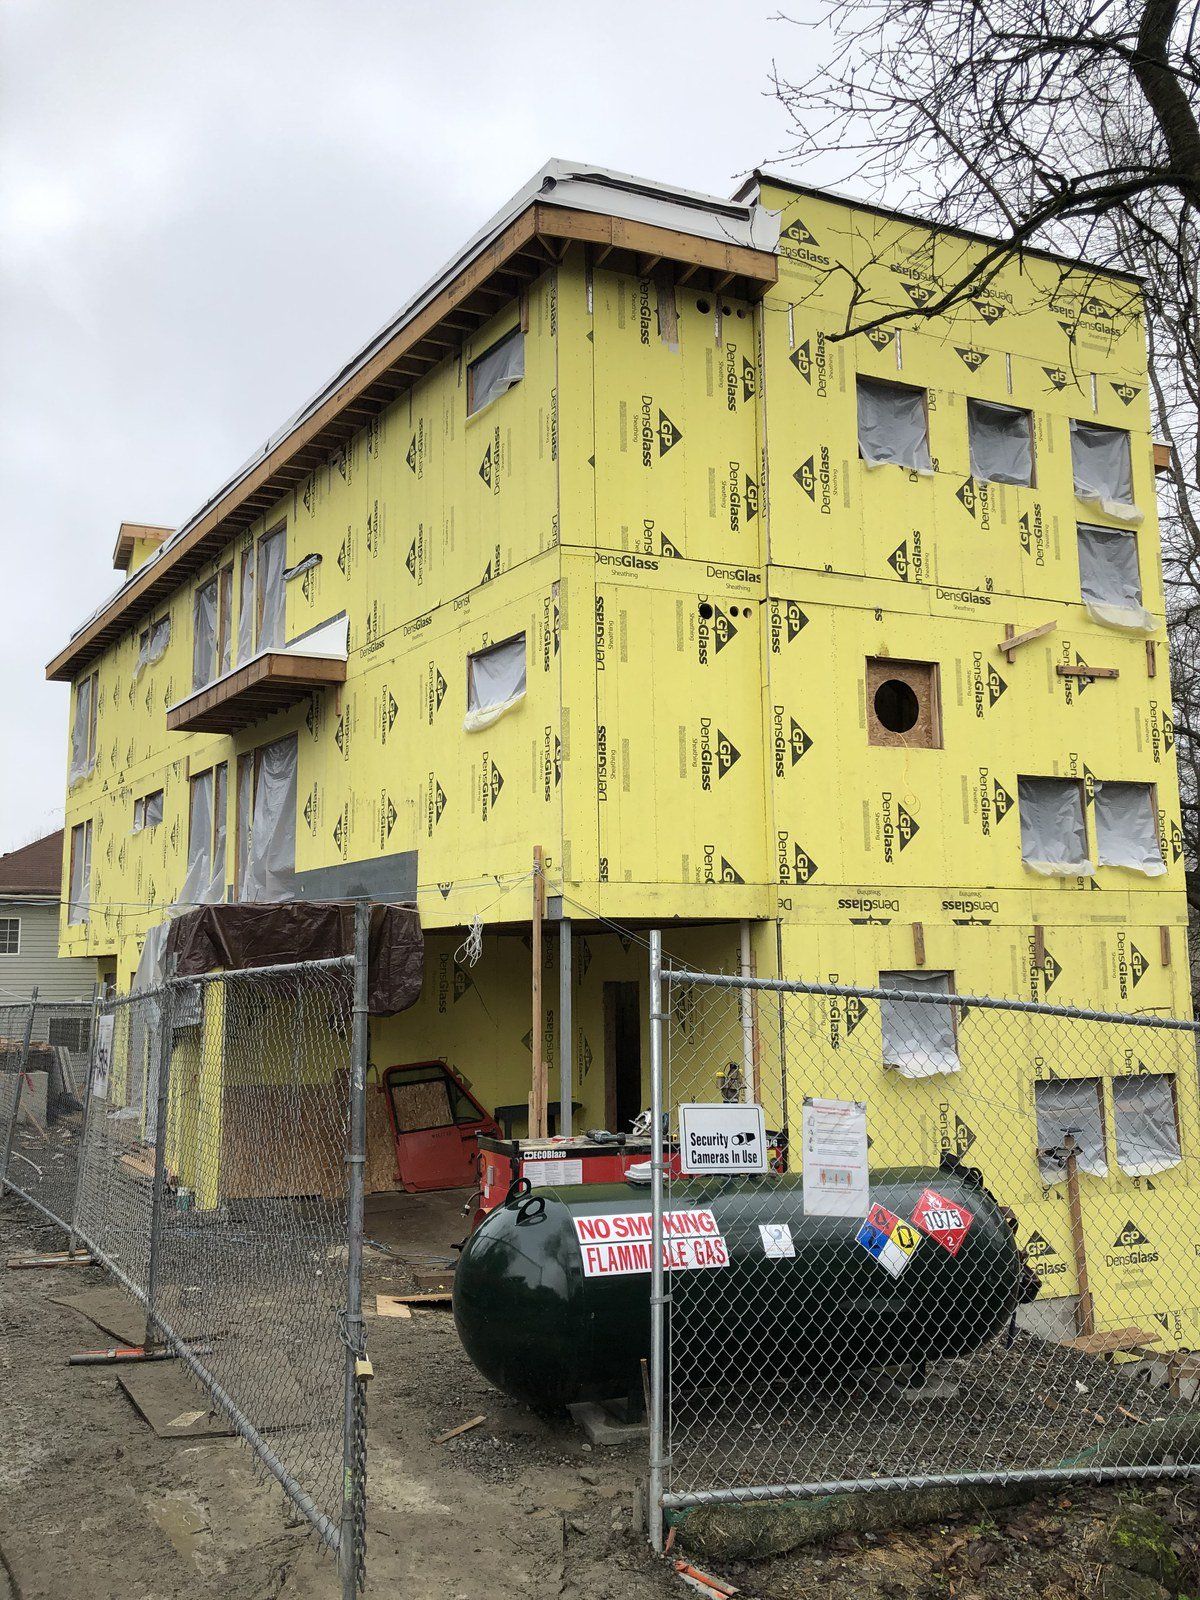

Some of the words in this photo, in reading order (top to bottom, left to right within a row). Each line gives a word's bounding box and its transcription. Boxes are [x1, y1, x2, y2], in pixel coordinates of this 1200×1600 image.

[787, 226, 810, 241] GP
[780, 245, 829, 265] ensGlass
[909, 285, 930, 299] GP
[980, 306, 999, 317] GP
[1087, 304, 1103, 315] GP
[869, 331, 890, 342] GP
[798, 349, 810, 372] GP
[816, 331, 826, 397] DensGlass
[962, 352, 982, 364] GP
[726, 342, 737, 412] DensGlass
[745, 365, 755, 394] GP
[1050, 371, 1066, 383] GP
[1118, 387, 1134, 399] GP
[642, 395, 652, 468] DensGlass
[660, 420, 673, 447] GP
[802, 465, 814, 491] GP
[819, 446, 830, 514] DensGlass
[729, 462, 740, 532] DensGlass
[747, 485, 758, 513] GP
[963, 485, 974, 509] GP
[1020, 521, 1029, 545] GP
[1036, 503, 1044, 566] DensGlass
[611, 569, 638, 579] Sheathing
[896, 550, 907, 574] GP
[936, 588, 991, 606] DensGlass
[403, 616, 432, 637] DensGlass
[716, 617, 728, 643] GP
[788, 608, 800, 632] GP
[436, 676, 444, 700] GP
[972, 651, 983, 718] DensGlass
[990, 672, 999, 696] GP
[774, 705, 786, 778] DensGlass
[792, 729, 803, 754] GP
[1150, 700, 1160, 764] DensGlass
[1164, 720, 1174, 743] GP
[700, 717, 711, 791] DensGlass
[719, 740, 731, 767] GP
[492, 770, 500, 796] GP
[1085, 775, 1094, 796] GP
[436, 789, 444, 812] GP
[979, 767, 990, 836] DensGlass
[996, 788, 1007, 813] GP
[882, 792, 893, 863] DensGlass
[901, 816, 910, 839] GP
[1173, 829, 1182, 852] GP
[797, 854, 808, 880] GP
[838, 899, 899, 912] DensGlass
[942, 900, 998, 912] DensGlass
[1045, 956, 1055, 981] GP
[1117, 932, 1127, 1000] DensGlass
[1132, 953, 1142, 976] GP
[439, 953, 449, 1014] DensGlass
[690, 1132, 728, 1148] Security
[533, 1151, 566, 1160] ECOBlaze
[691, 1150, 729, 1164] Cameras
[732, 1150, 740, 1160] In
[742, 1150, 758, 1163] Use
[578, 1218, 610, 1240] NO
[613, 1212, 715, 1237] SMKING
[923, 1209, 963, 1230] 1075
[897, 1225, 914, 1248] 0
[947, 1236, 954, 1246] 2
[1027, 1241, 1046, 1256] GP
[1121, 1231, 1139, 1245] GP
[587, 1241, 688, 1273] FLAMMBLE
[694, 1239, 726, 1265] GAS
[1106, 1251, 1158, 1267] DensGlass
